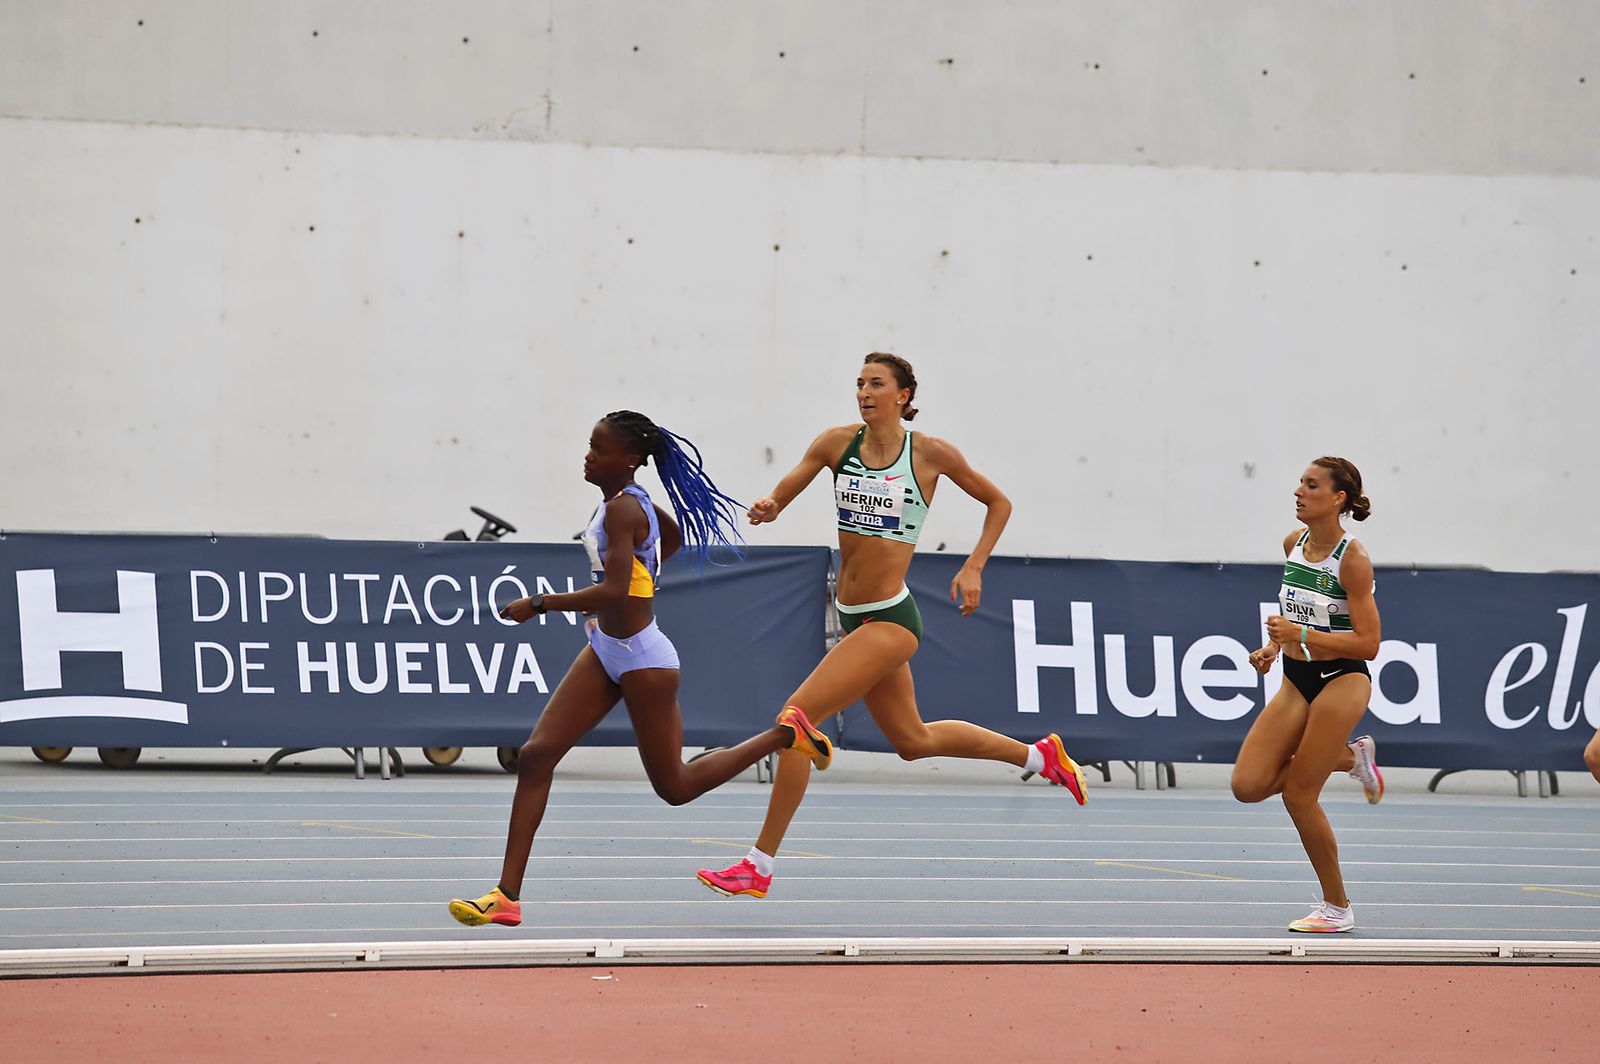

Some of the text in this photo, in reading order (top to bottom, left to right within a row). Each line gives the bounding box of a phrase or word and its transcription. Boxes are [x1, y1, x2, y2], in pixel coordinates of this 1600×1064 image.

[842, 491, 893, 508] HERING
[190, 565, 577, 626] DIPUTACIÓN
[1286, 603, 1316, 618] SILVA
[194, 641, 549, 694] DE HUELVA
[1012, 599, 1441, 725] Huela
